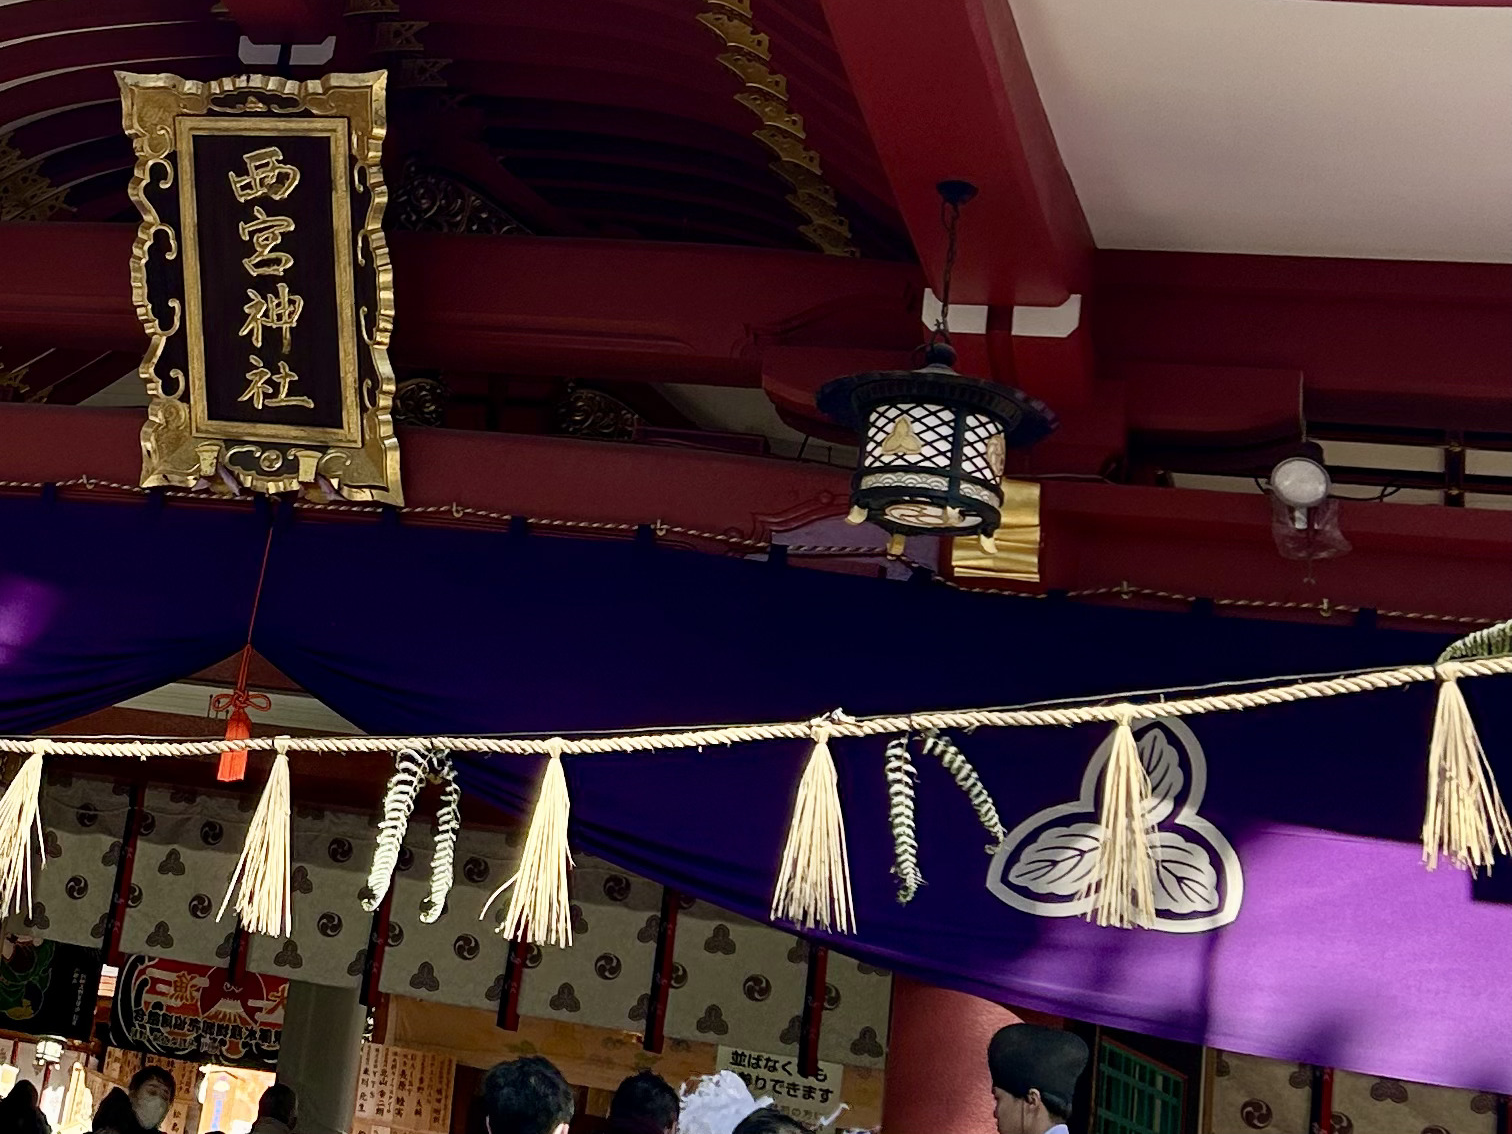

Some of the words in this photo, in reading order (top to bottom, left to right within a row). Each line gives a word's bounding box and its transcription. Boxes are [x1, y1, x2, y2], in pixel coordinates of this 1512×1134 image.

[228, 145, 315, 410] 西宮神社
[729, 1049, 827, 1083] 並ばなくも
